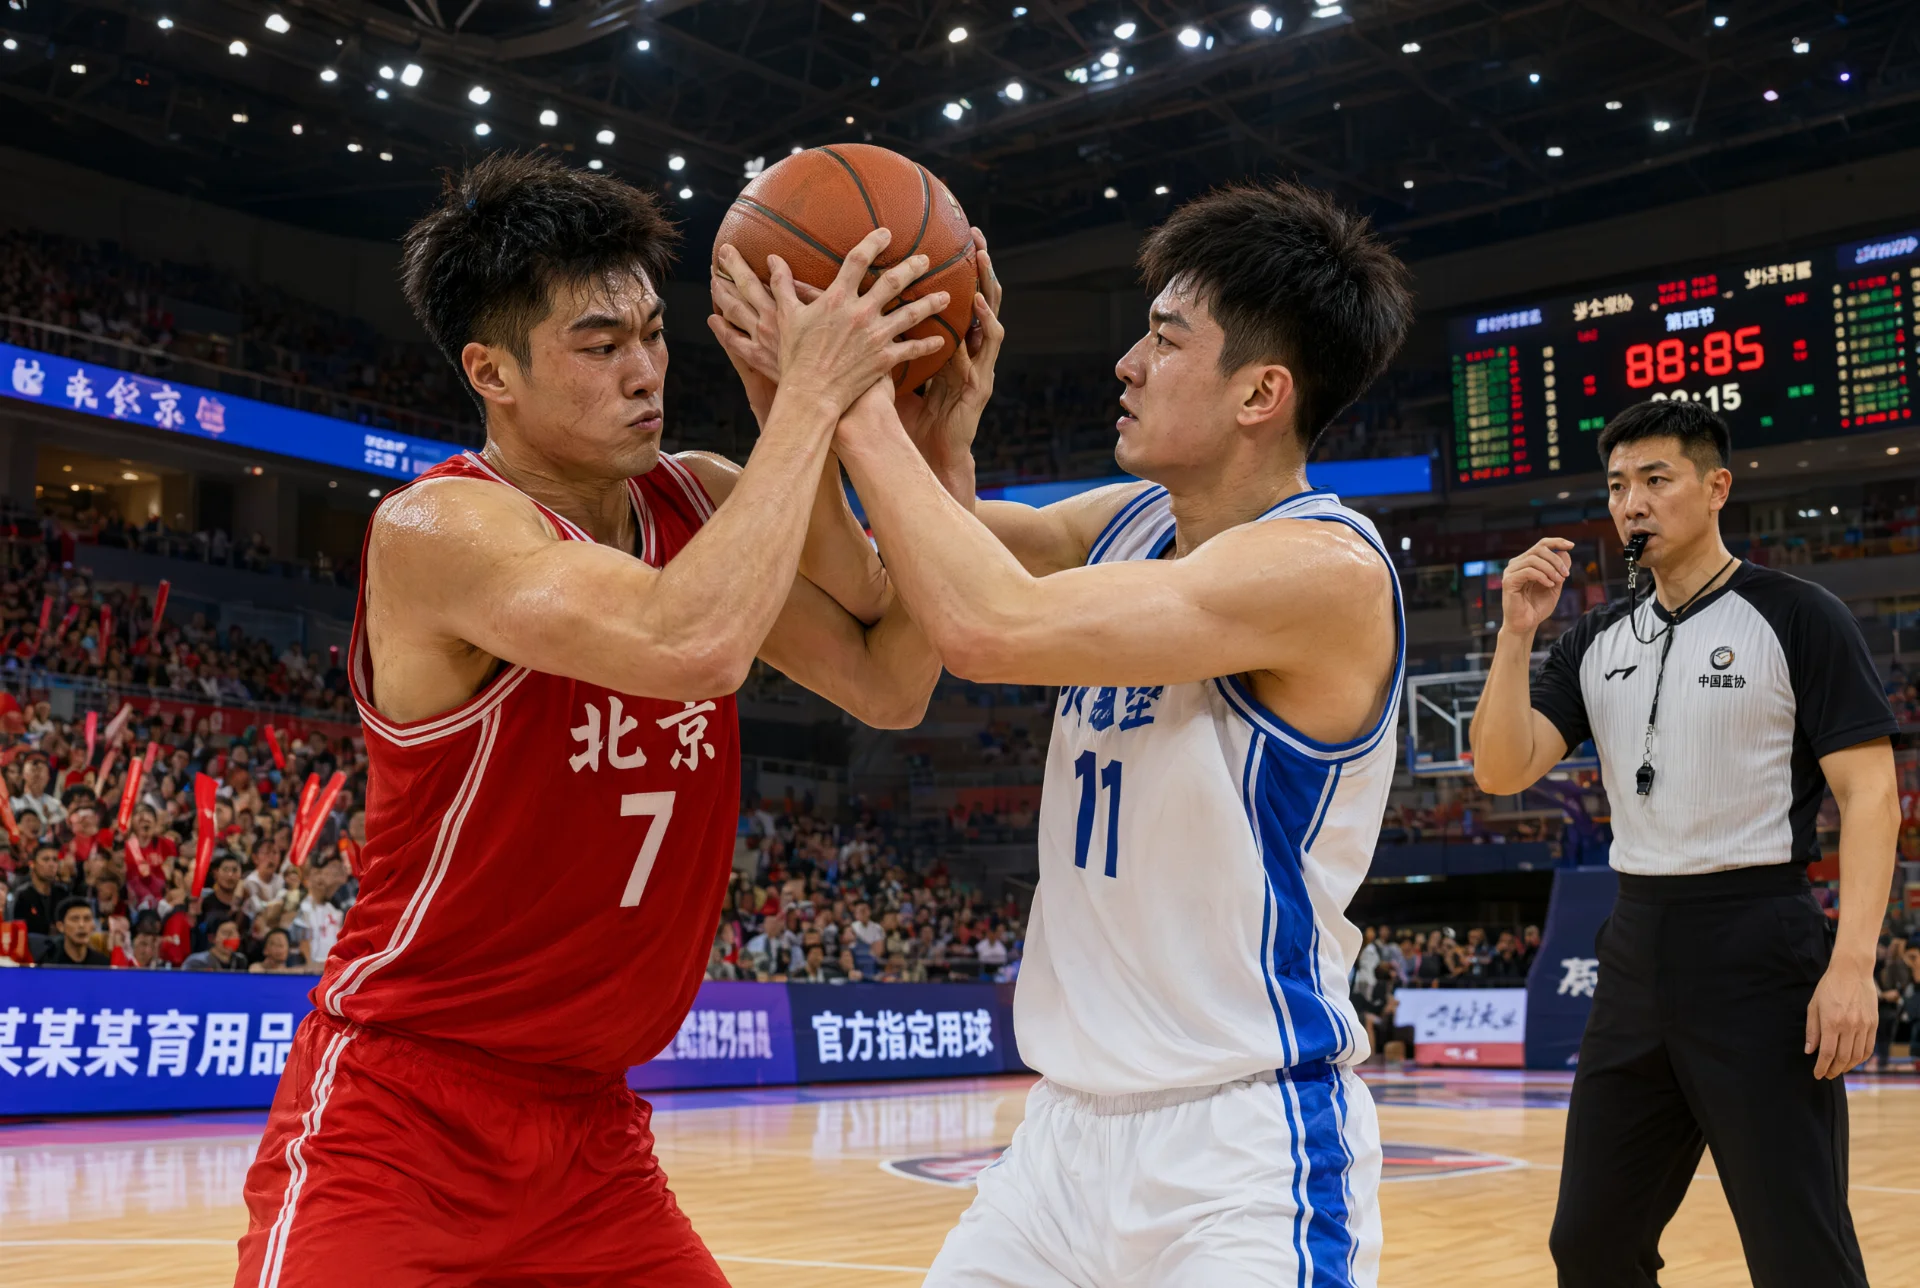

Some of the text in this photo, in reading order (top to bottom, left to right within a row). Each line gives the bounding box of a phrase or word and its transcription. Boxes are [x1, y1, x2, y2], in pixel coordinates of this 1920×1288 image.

[1665, 307, 1715, 332] 第四节
[1625, 325, 1764, 389] 88:85
[1698, 674, 1747, 689] 中国篮协
[568, 695, 717, 773] 北京
[1074, 750, 1123, 879] 11
[620, 791, 676, 907] 7
[812, 1009, 994, 1063] 官方指定用球
